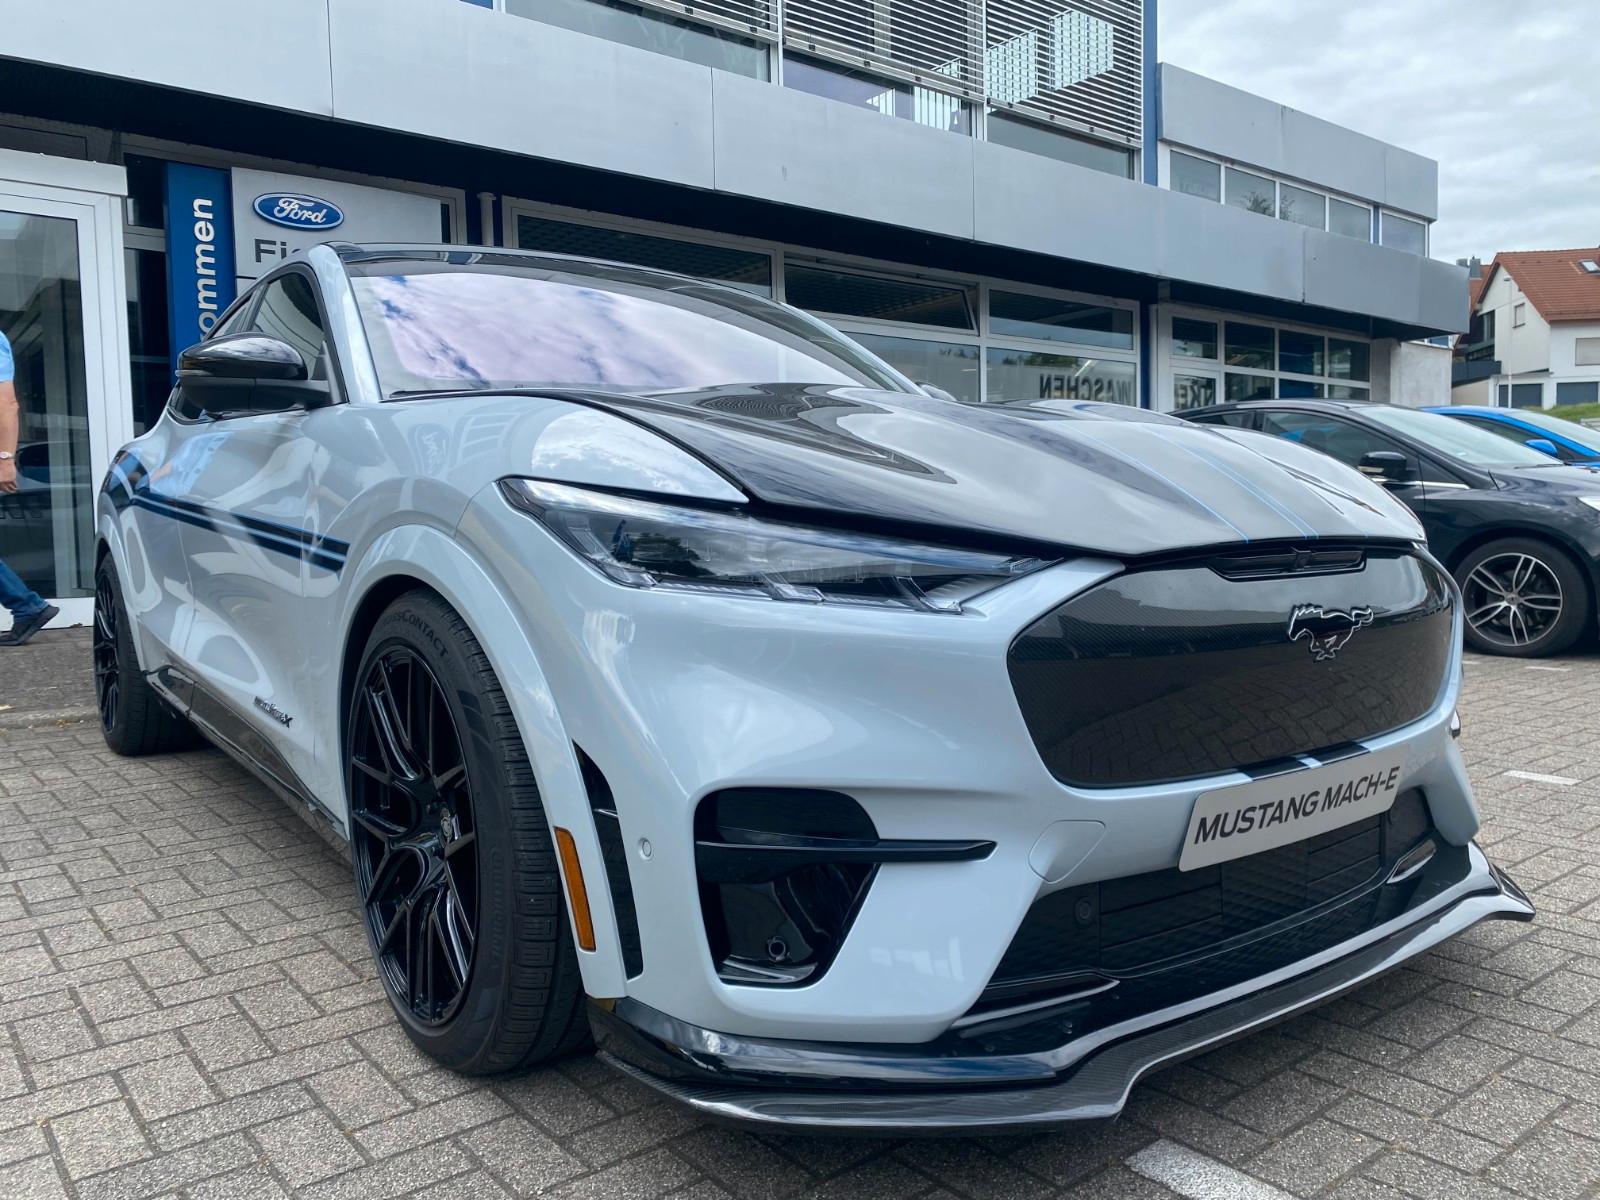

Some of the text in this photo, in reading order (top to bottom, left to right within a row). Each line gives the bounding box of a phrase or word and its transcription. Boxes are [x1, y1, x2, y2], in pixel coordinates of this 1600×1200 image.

[273, 197, 328, 224] Ford
[193, 198, 218, 341] ommen
[254, 238, 301, 263] Fi
[1193, 766, 1400, 845] MUSTANG MACH-E
